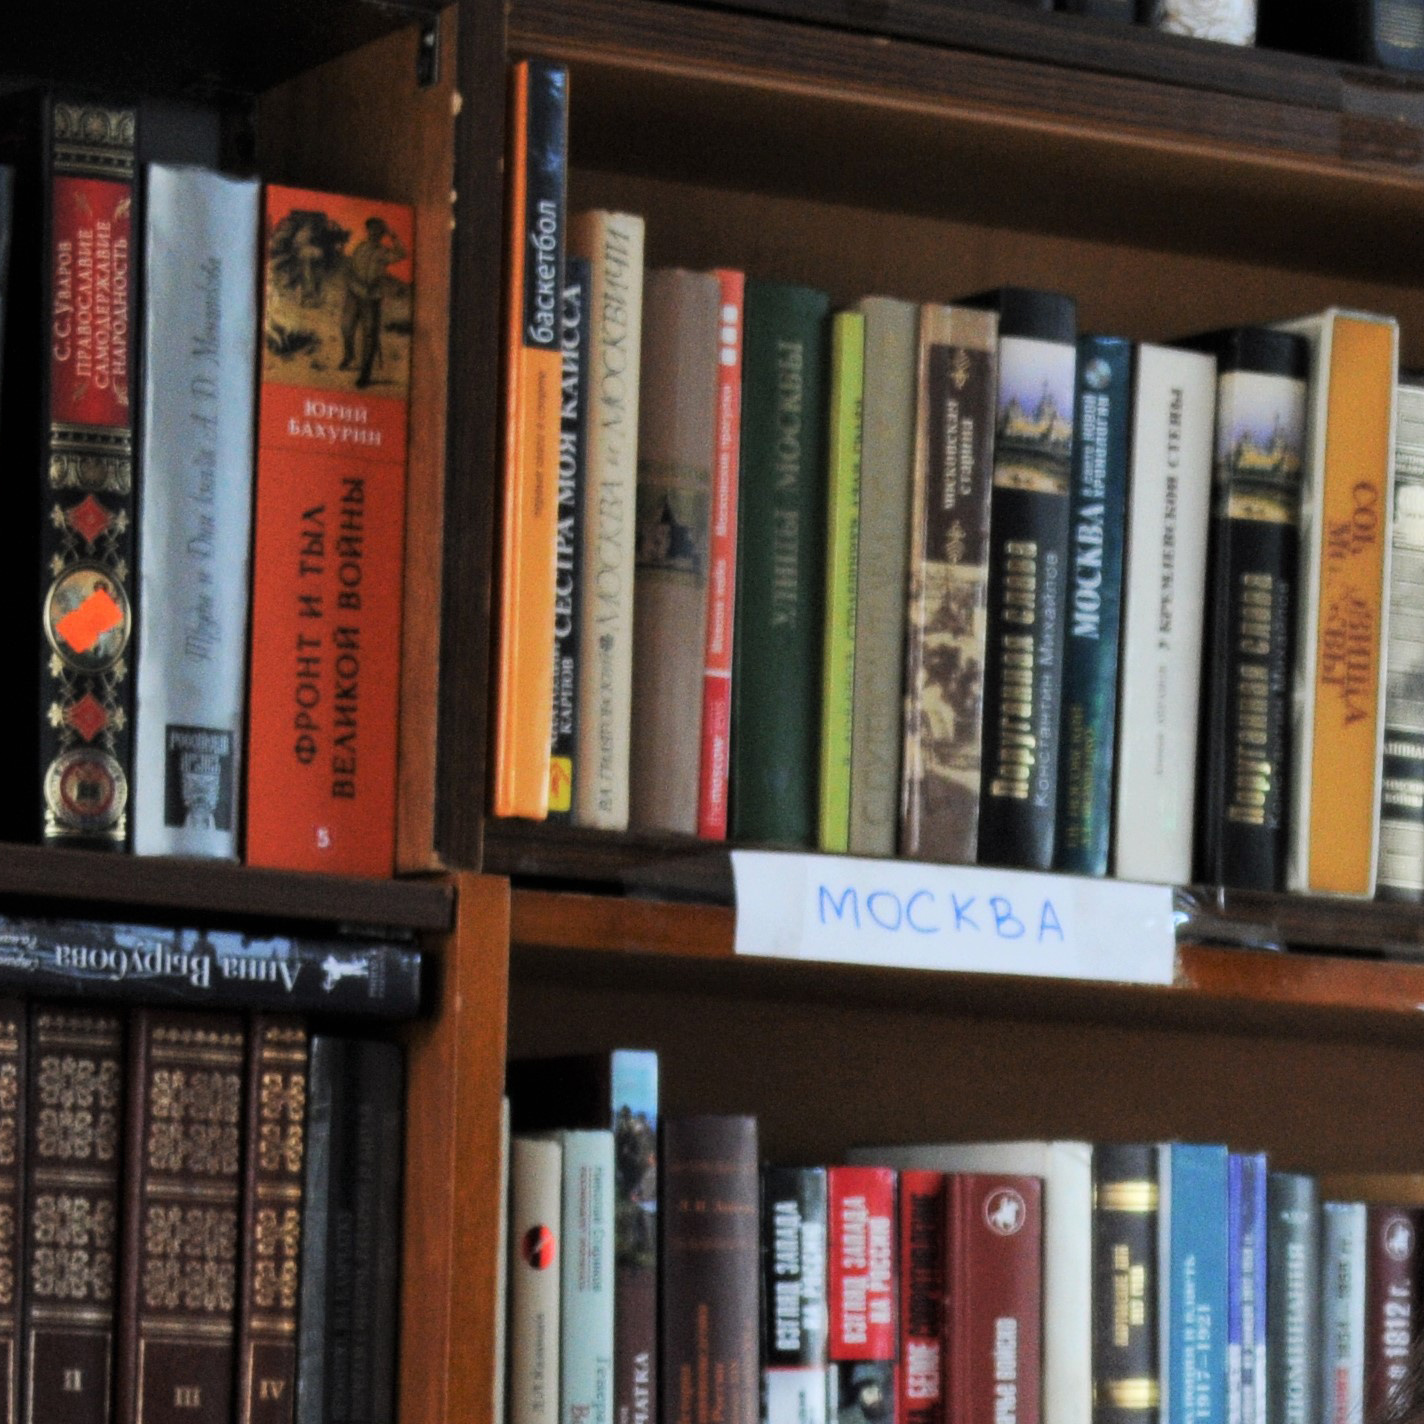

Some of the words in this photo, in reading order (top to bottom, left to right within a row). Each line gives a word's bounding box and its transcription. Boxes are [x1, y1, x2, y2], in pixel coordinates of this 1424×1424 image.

[526, 201, 558, 343] баскетбол
[300, 505, 325, 575] ТЫЛ
[334, 477, 366, 611] ВОЙНЫ
[1071, 504, 1105, 640] МОСКВА
[294, 631, 322, 764] ФРОНТ
[332, 627, 363, 801] ВЕЛИКОЙ
[817, 884, 1066, 943] МОСКВА
[1383, 1300, 1411, 1358] 1812
